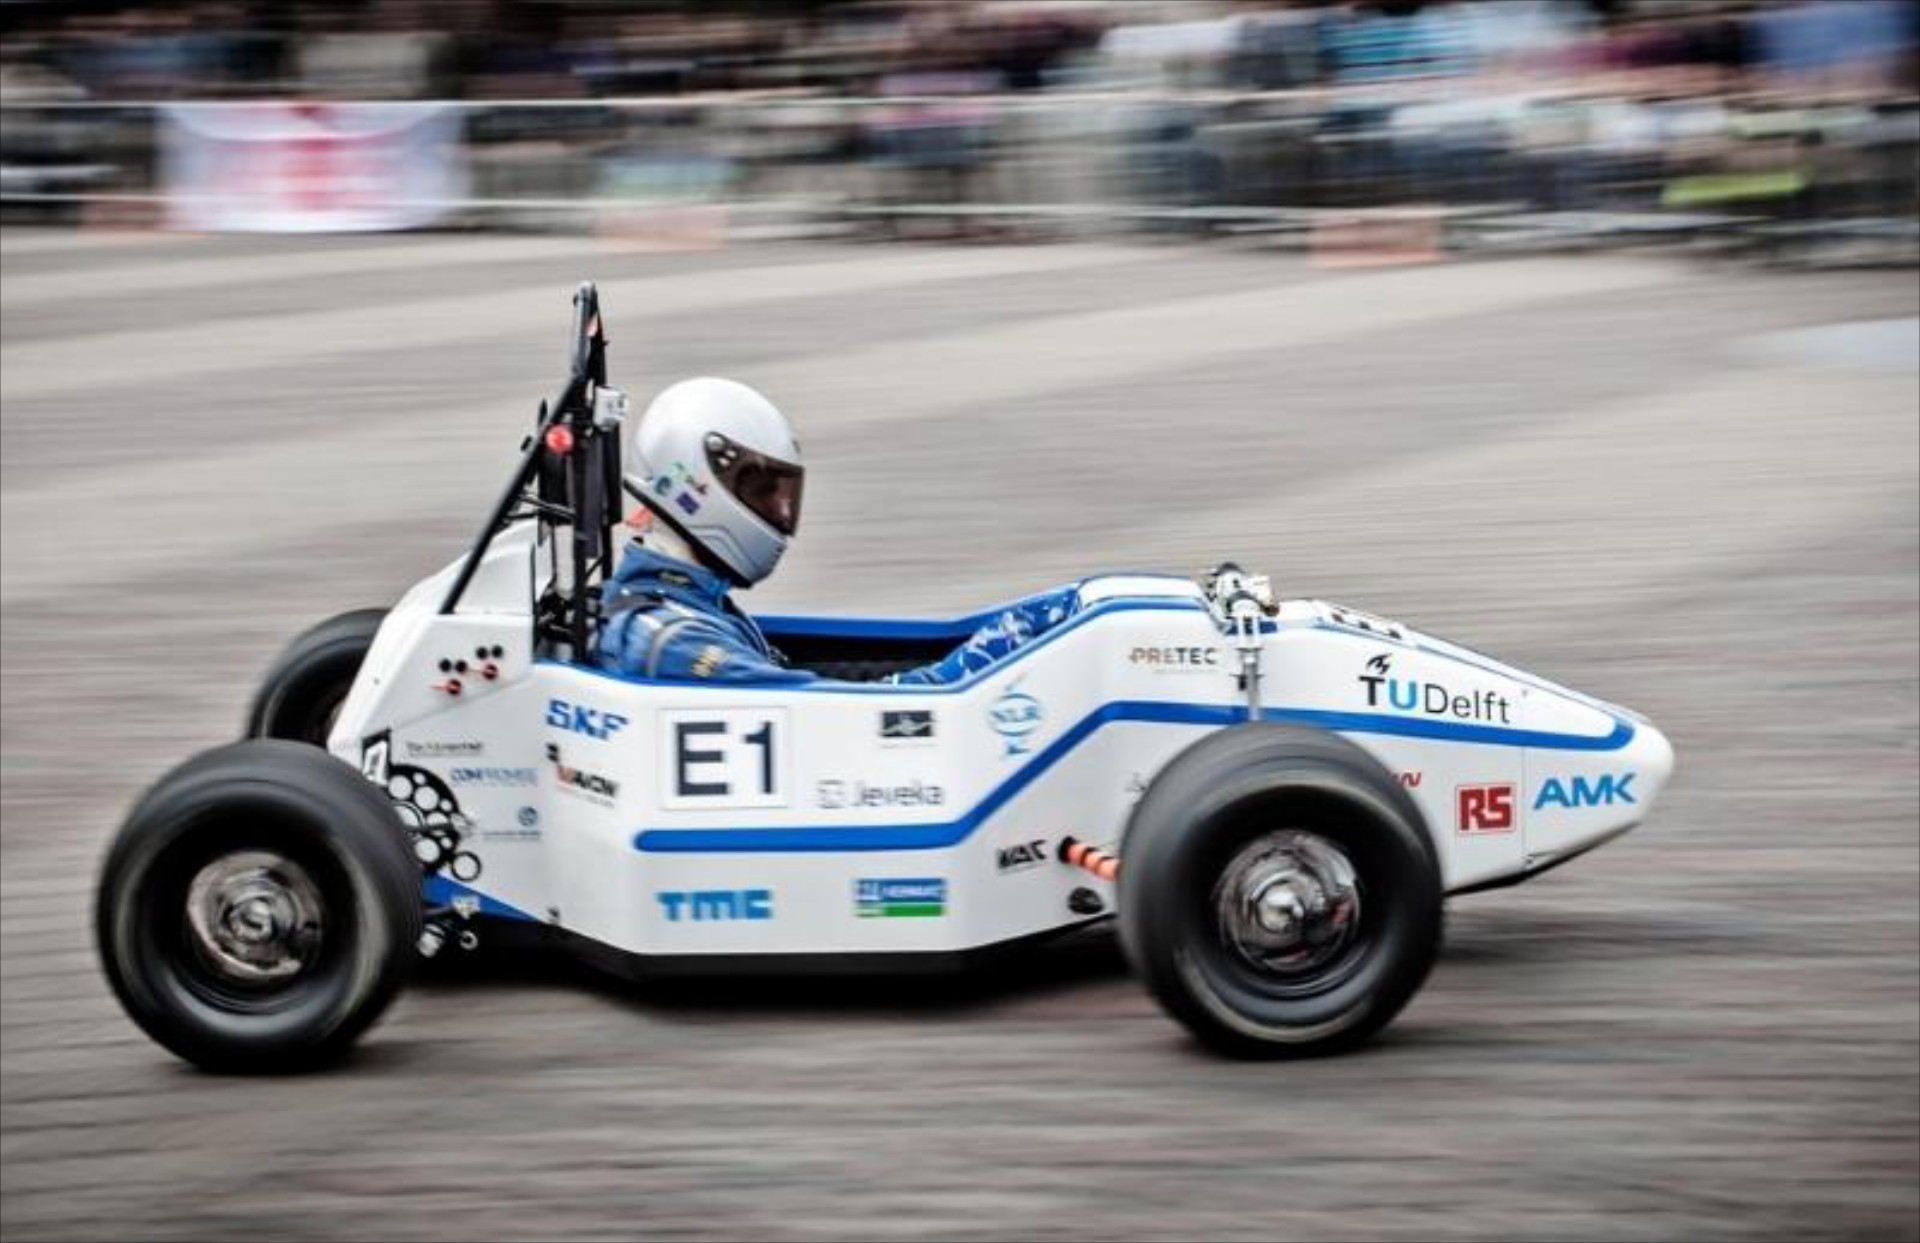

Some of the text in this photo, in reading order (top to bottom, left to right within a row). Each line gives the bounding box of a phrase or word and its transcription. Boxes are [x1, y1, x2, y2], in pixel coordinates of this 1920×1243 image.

[1130, 646, 1218, 665] PRETEC
[546, 698, 630, 741] SKF
[675, 721, 774, 796] E1
[1458, 786, 1513, 832] RS
[1532, 772, 1638, 811] AMK
[656, 888, 775, 922] TMC
